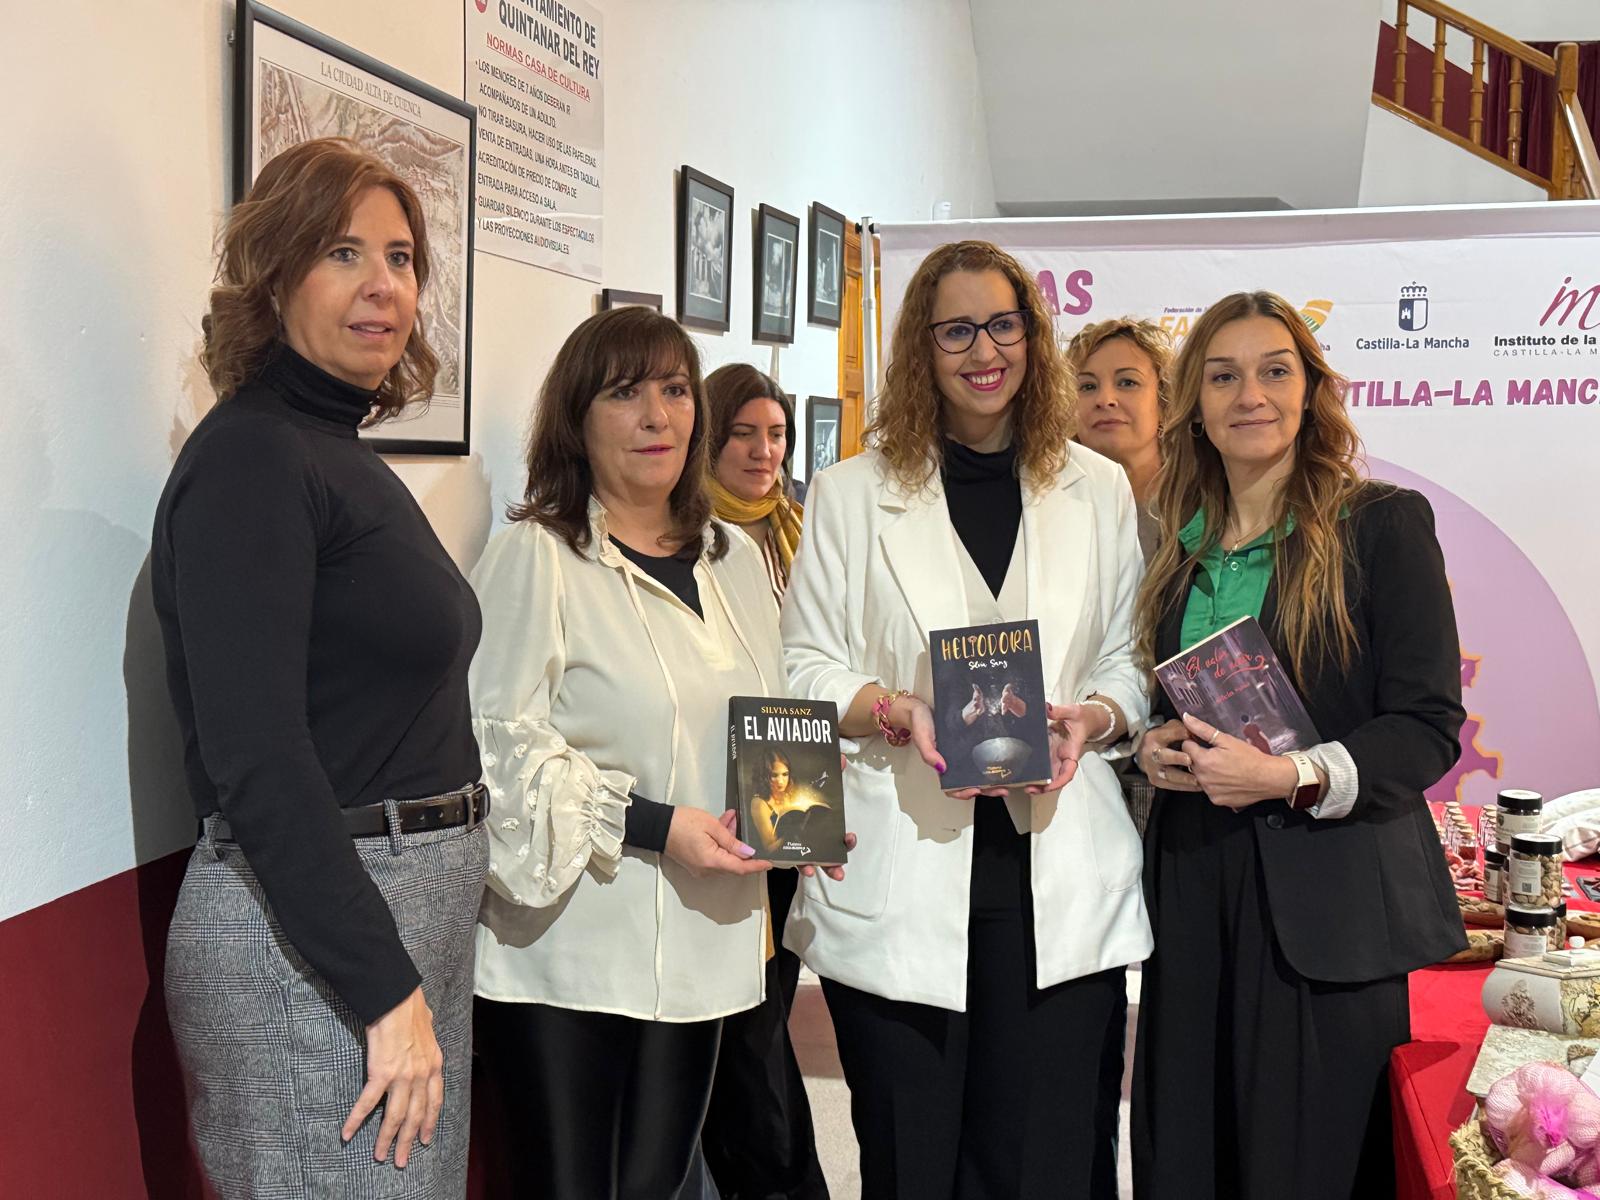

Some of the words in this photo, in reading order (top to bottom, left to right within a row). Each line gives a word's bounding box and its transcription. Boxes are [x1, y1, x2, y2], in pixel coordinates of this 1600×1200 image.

[499, 0, 561, 57] QUINTANAR
[563, 38, 580, 68] DEL
[583, 50, 600, 80] REY
[584, 20, 596, 48] DE
[478, 59, 490, 74] LOS
[490, 65, 516, 88] MENORES
[518, 79, 525, 92] DE
[525, 83, 528, 94] 7
[530, 84, 543, 101] AÑOS
[486, 32, 523, 62] NORMAS
[525, 54, 546, 77] CASA
[548, 66, 558, 83] DE
[560, 73, 590, 101] CULTURA
[321, 62, 332, 78] LA
[333, 66, 364, 92] CIUDAD
[365, 80, 382, 101] ALTA
[384, 88, 393, 105] DE
[394, 94, 422, 119] CUENCA
[479, 82, 520, 111] ACOMPAÑADOS
[521, 102, 528, 115] DE
[529, 107, 536, 118] UN
[478, 104, 486, 118] NO
[488, 108, 504, 126] TIRAR
[528, 128, 546, 144] HACER
[546, 136, 555, 148] USO
[556, 139, 563, 153] DE
[563, 143, 572, 157] LAS
[478, 127, 496, 144] VENTA
[496, 134, 504, 148] DE
[534, 152, 544, 164] UNA
[545, 156, 558, 170] HORA
[558, 162, 573, 178] ANTES
[574, 168, 580, 180] EN
[478, 173, 504, 190] ENTRADA
[504, 181, 518, 196] PARA
[518, 186, 538, 204] ACCESO
[540, 194, 544, 204] A
[518, 166, 526, 178] DE
[526, 170, 544, 184] PRECIO
[544, 176, 552, 188] DE
[552, 180, 570, 196] COMPRA
[570, 186, 577, 198] DE
[478, 195, 505, 215] GUARDAR
[506, 204, 528, 223] SILENCIO
[530, 213, 552, 230] DURANTE
[552, 219, 561, 233] LOS
[478, 216, 482, 229] Y
[482, 219, 494, 232] LAS
[494, 222, 534, 244] PROYECCIONES
[1037, 270, 1093, 316] AS
[1356, 338, 1420, 350] Castilla-La
[1424, 336, 1470, 348] Mancha
[1493, 348, 1581, 357] CASTILLA-LA
[1494, 335, 1556, 346] Instituto
[1560, 334, 1579, 345] de
[1583, 334, 1597, 345] la
[1507, 378, 1600, 406] MANC
[941, 628, 1033, 661] HELIODORA
[968, 660, 988, 671] Silvia
[761, 706, 788, 715] SILVIA
[789, 707, 812, 716] SANZ
[744, 715, 763, 741] EL
[767, 717, 832, 744] AVIADOR
